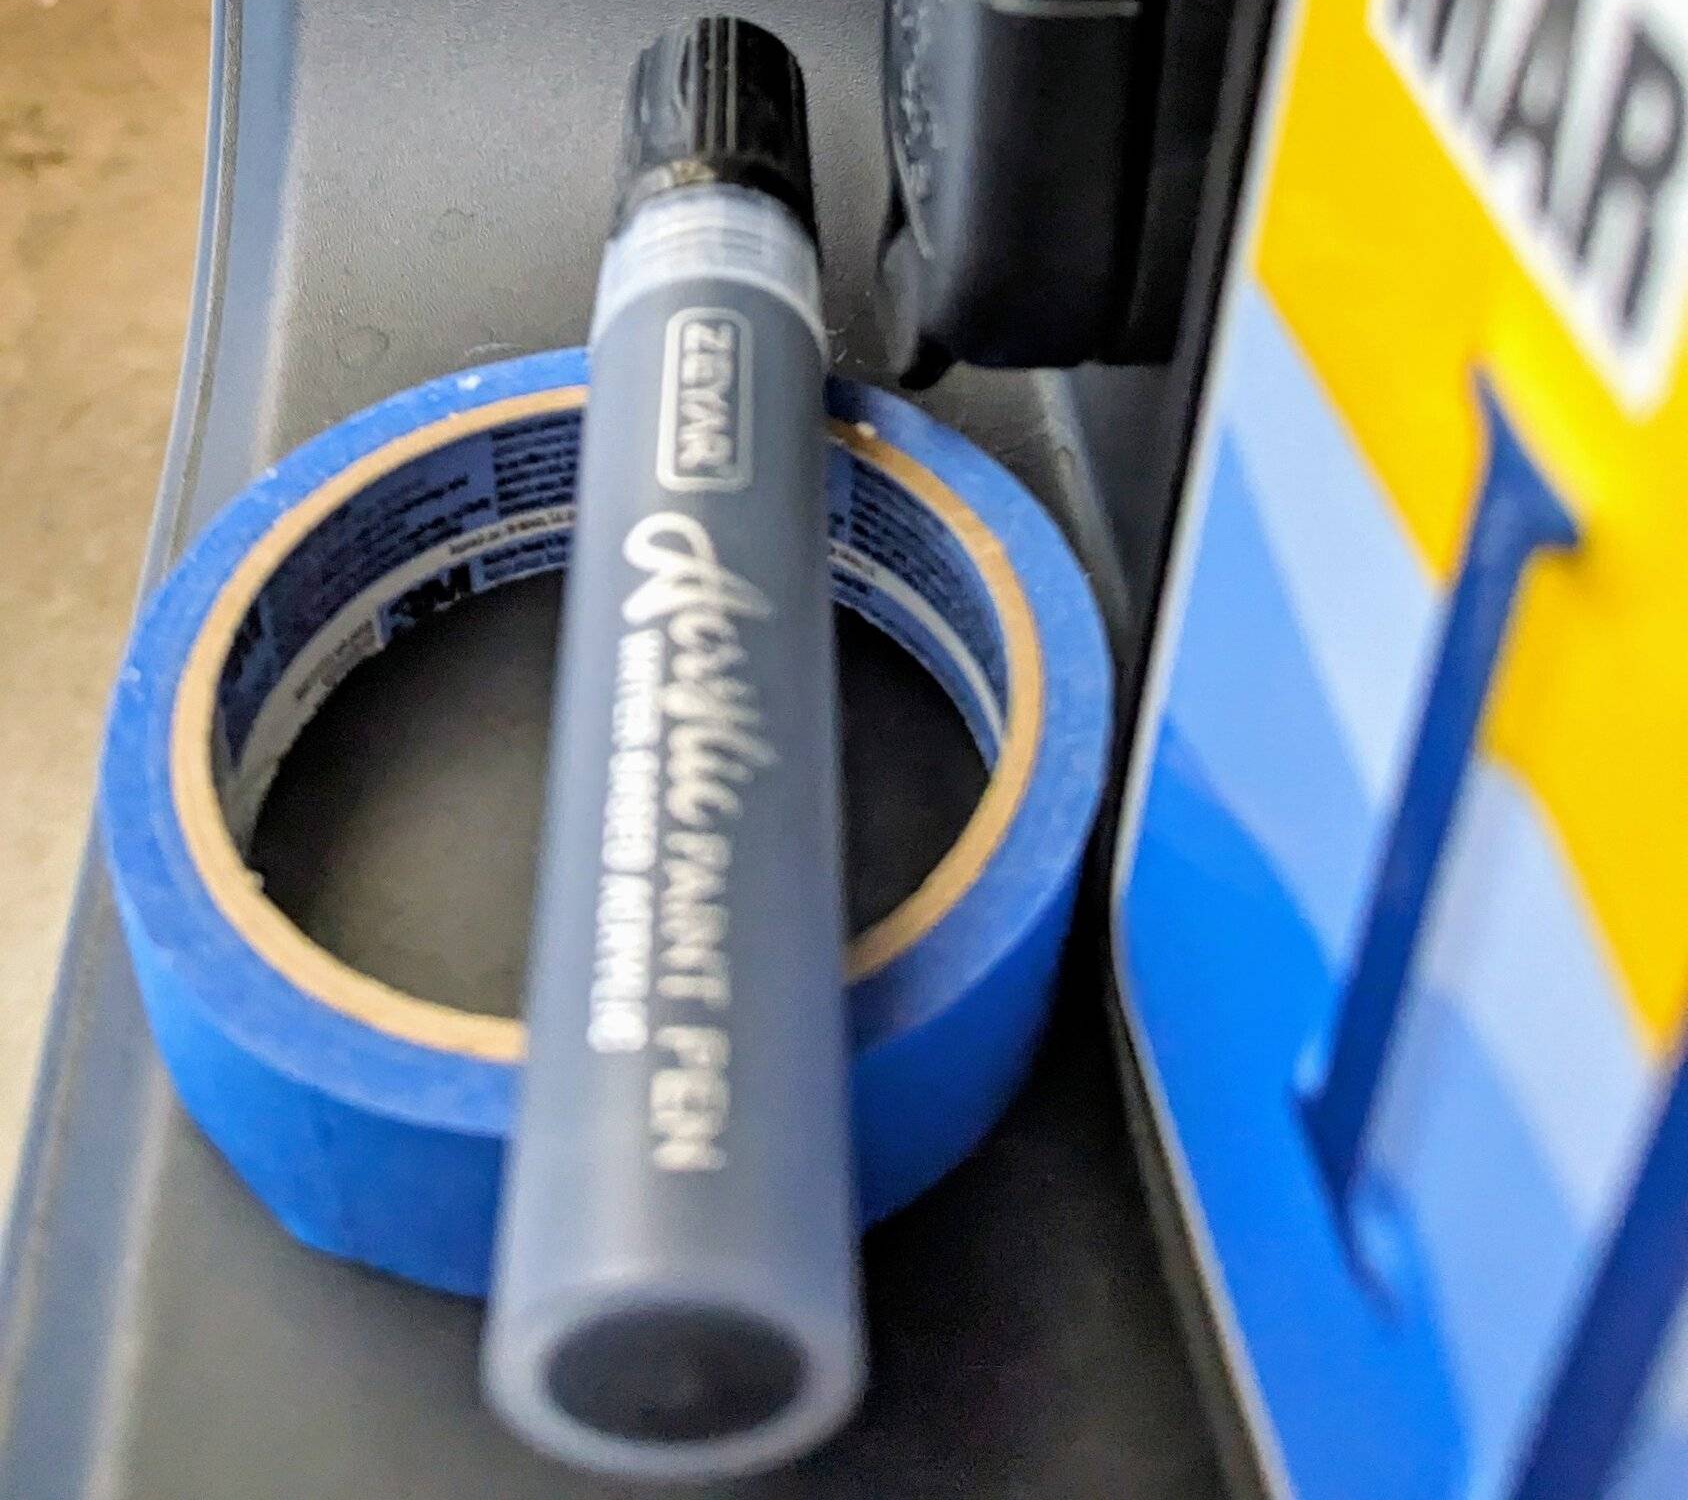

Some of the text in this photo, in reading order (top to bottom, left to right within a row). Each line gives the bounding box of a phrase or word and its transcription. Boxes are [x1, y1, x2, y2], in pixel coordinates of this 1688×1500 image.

[673, 319, 737, 479] ZEYAR
[622, 511, 780, 1172] Acrylic PAINT PEN
